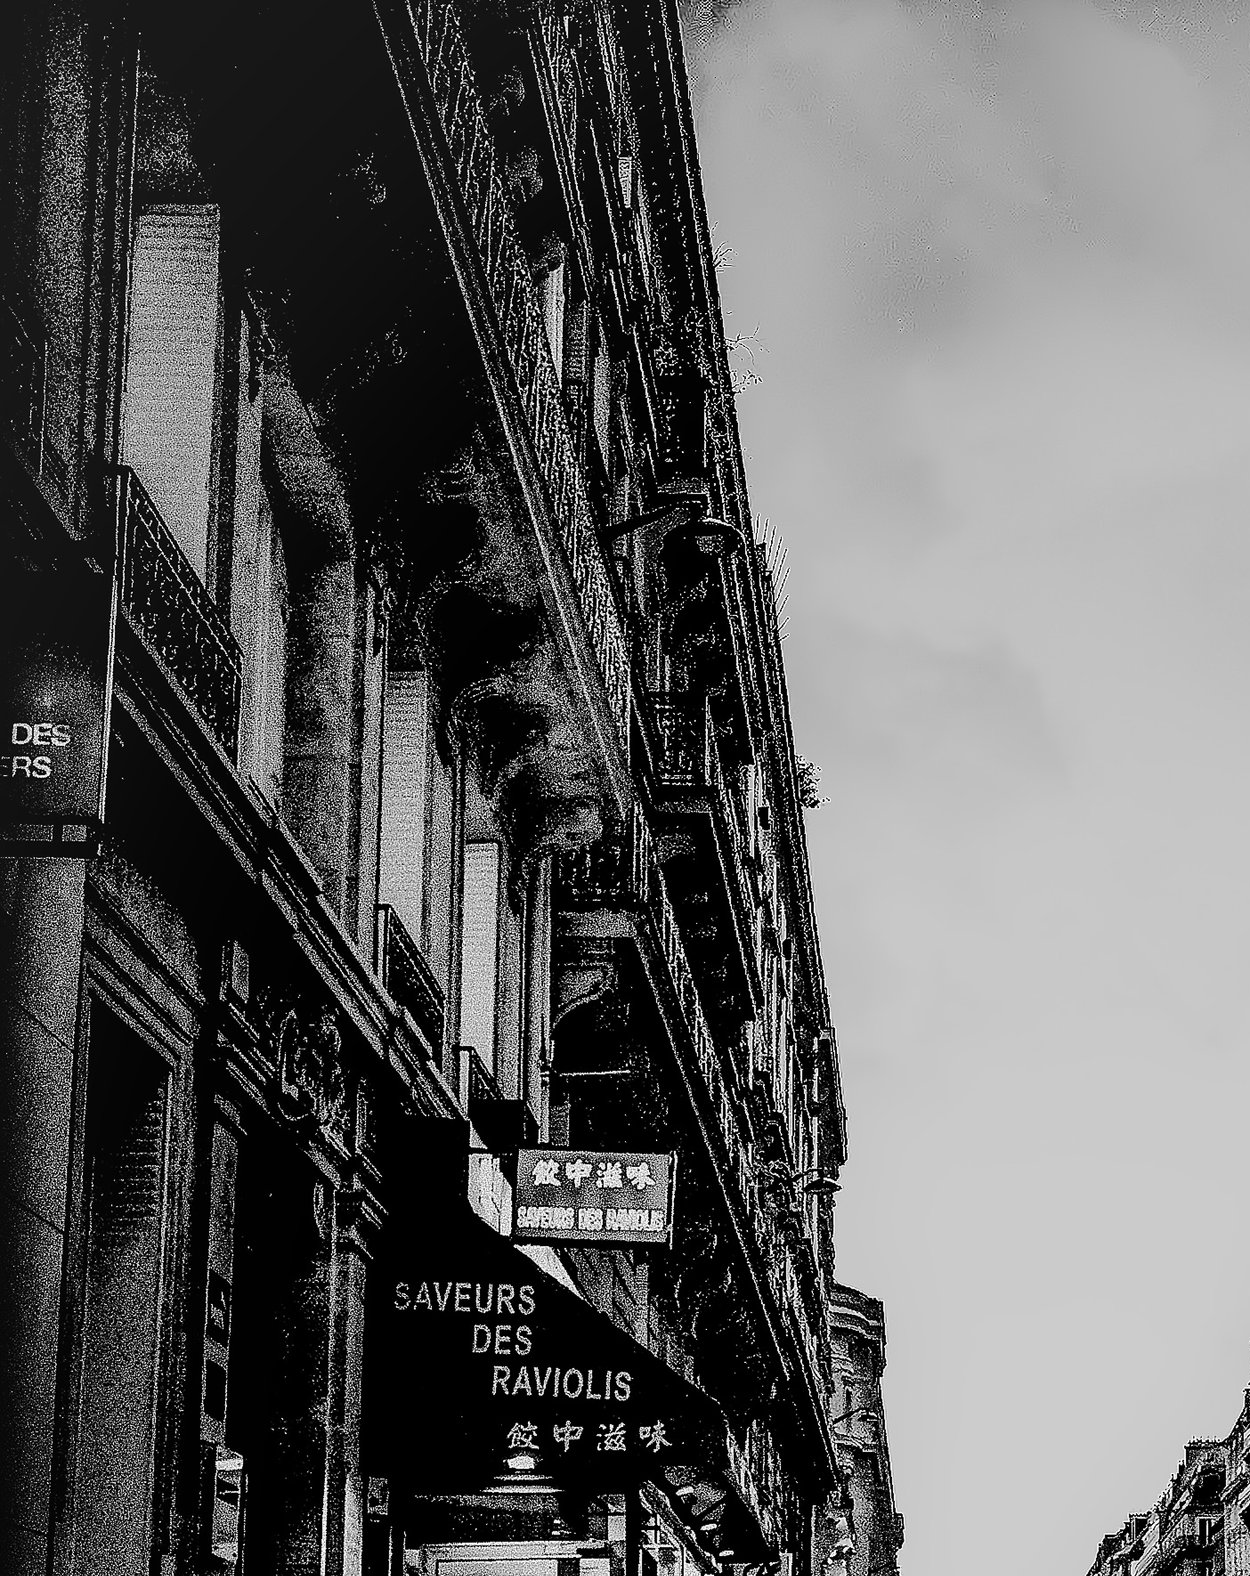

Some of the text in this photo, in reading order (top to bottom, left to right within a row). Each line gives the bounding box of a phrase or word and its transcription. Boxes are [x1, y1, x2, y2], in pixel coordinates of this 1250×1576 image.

[11, 722, 70, 746] DES
[516, 1206, 665, 1232] SAVEURS DES RAVIOLIS
[394, 1282, 536, 1315] SAVEURS
[472, 1324, 533, 1355] DES
[492, 1365, 634, 1401] RAVIOLIS
[507, 1420, 673, 1452] 餃中滋味
